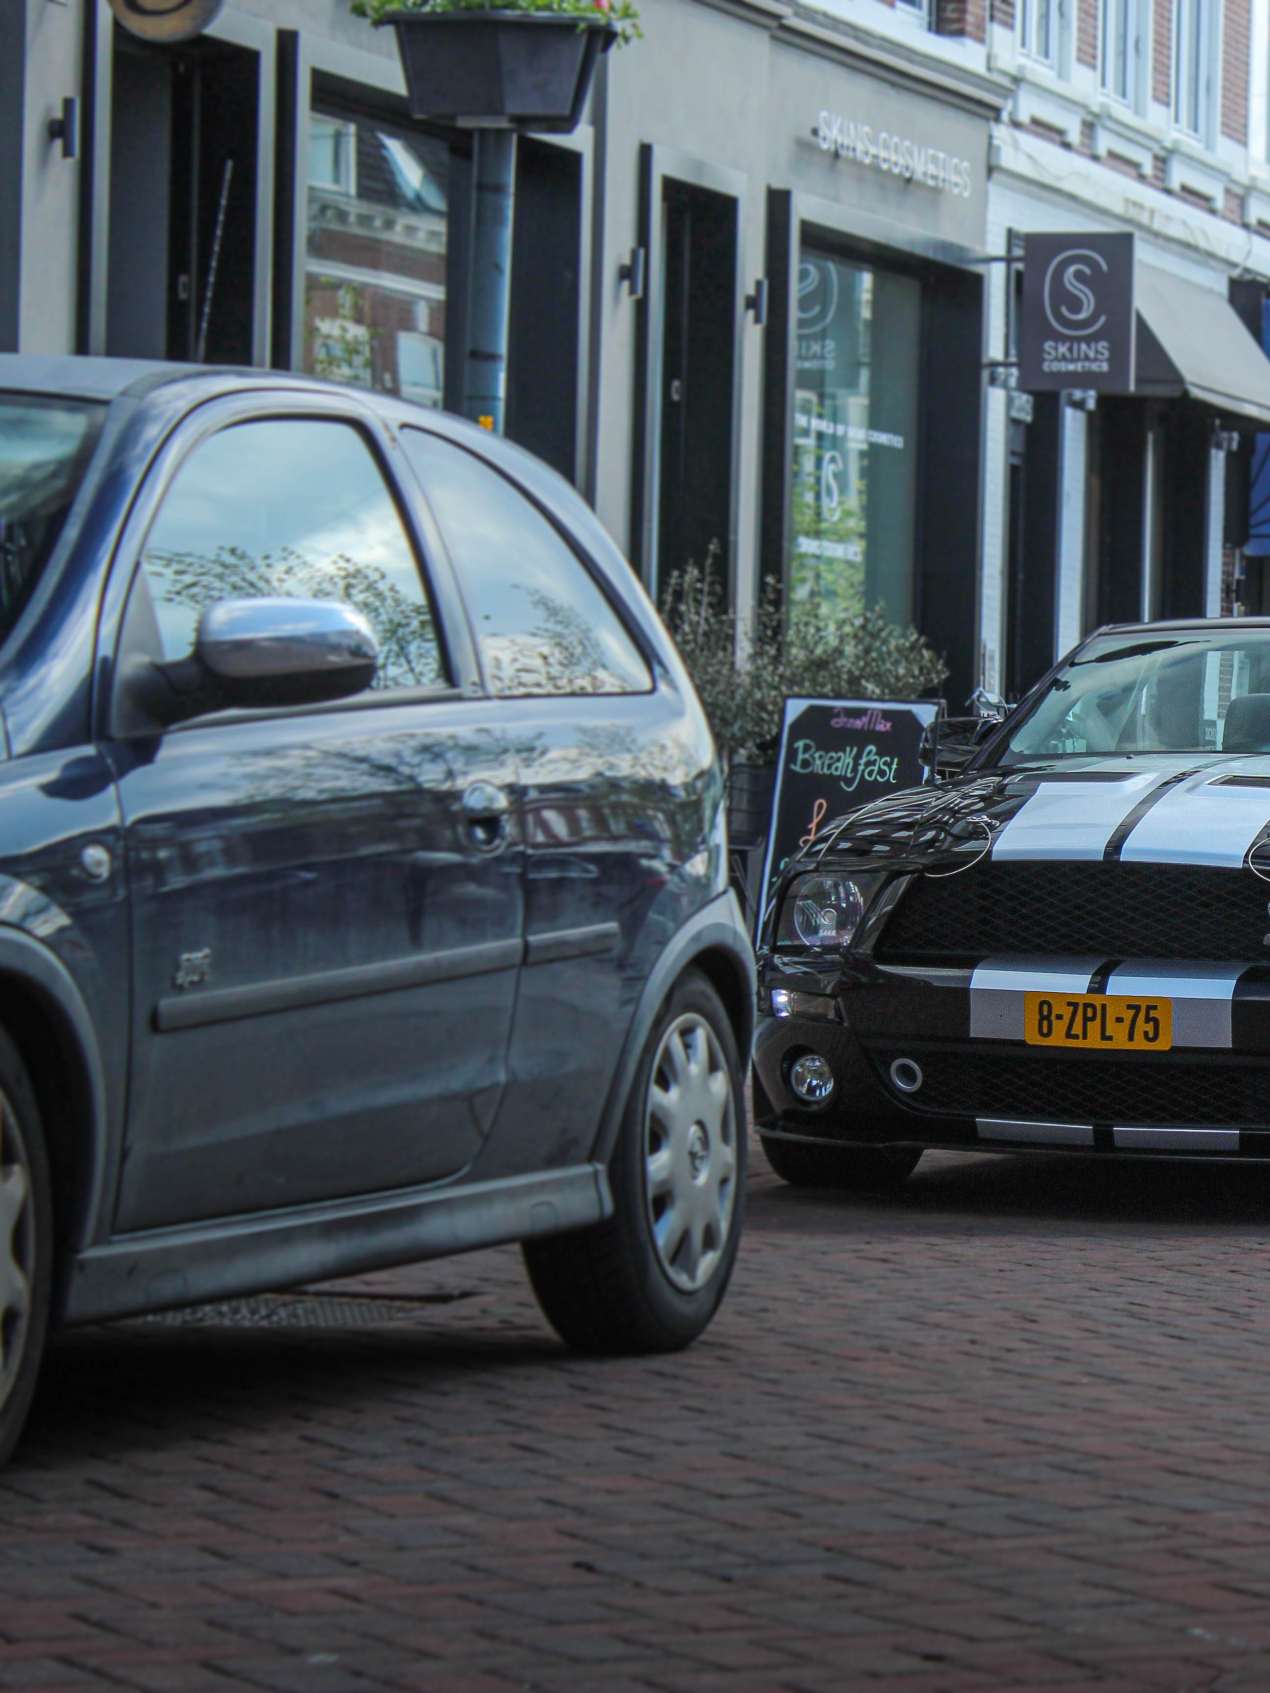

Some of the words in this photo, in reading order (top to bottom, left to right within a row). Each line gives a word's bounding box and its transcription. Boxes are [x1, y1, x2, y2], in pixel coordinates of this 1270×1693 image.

[818, 110, 873, 165] SKINS
[878, 131, 972, 198] COSMETICS
[1042, 340, 1110, 360] SKINS
[1042, 360, 1110, 373] COSMETICS
[1037, 999, 1161, 1043] 8-ZPL-75
